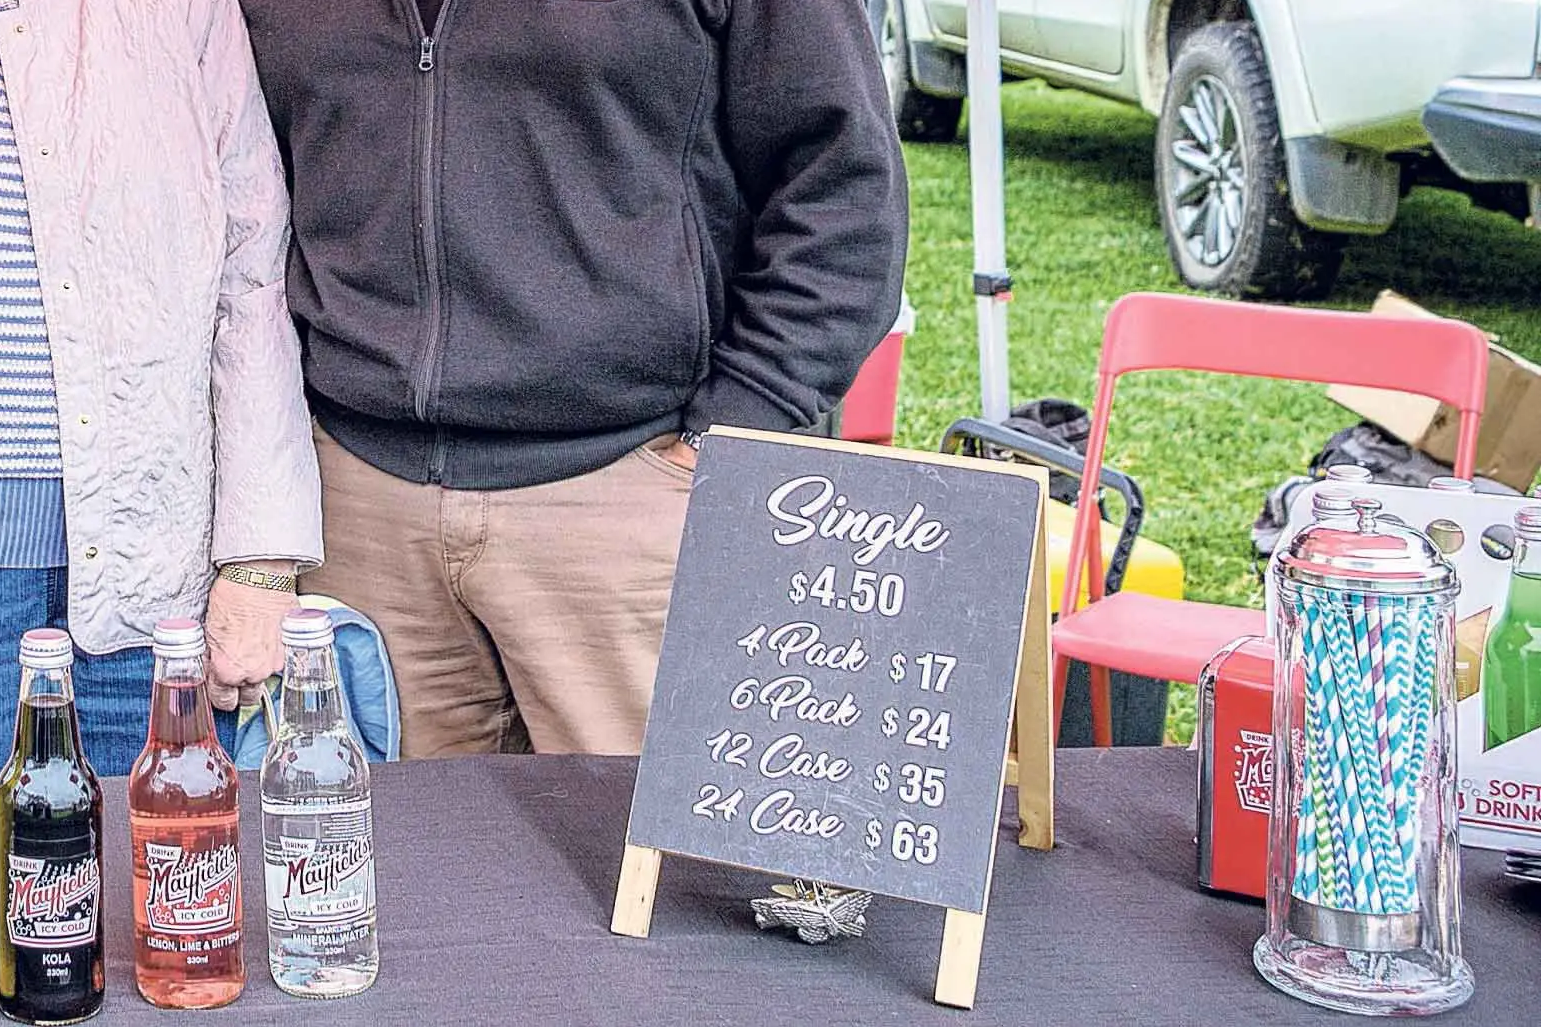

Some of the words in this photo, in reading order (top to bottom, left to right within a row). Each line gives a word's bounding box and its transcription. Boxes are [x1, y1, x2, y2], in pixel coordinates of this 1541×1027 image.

[766, 474, 951, 566] Single
[788, 564, 906, 617] $4.50
[736, 624, 768, 658] 4
[767, 621, 871, 672] Pack
[730, 678, 760, 711] 6
[759, 675, 862, 728] Pack
[706, 728, 754, 769] 12
[758, 733, 854, 782] Case
[692, 783, 745, 822] 24
[749, 788, 846, 839] Case
[1475, 798, 1541, 822] DRINK
[1488, 779, 1541, 802] SOFT
[8, 861, 99, 918] Mayfields
[148, 847, 235, 905] Mayfields
[283, 837, 370, 898] Mayfields
[41, 924, 57, 933] ICY
[61, 923, 85, 931] COLD
[180, 912, 196, 920] ICY
[200, 908, 223, 919] COLD
[292, 930, 336, 946] MINERAL
[340, 927, 370, 944] WATER
[42, 954, 71, 965] KOLA
[180, 941, 201, 951] LIME
